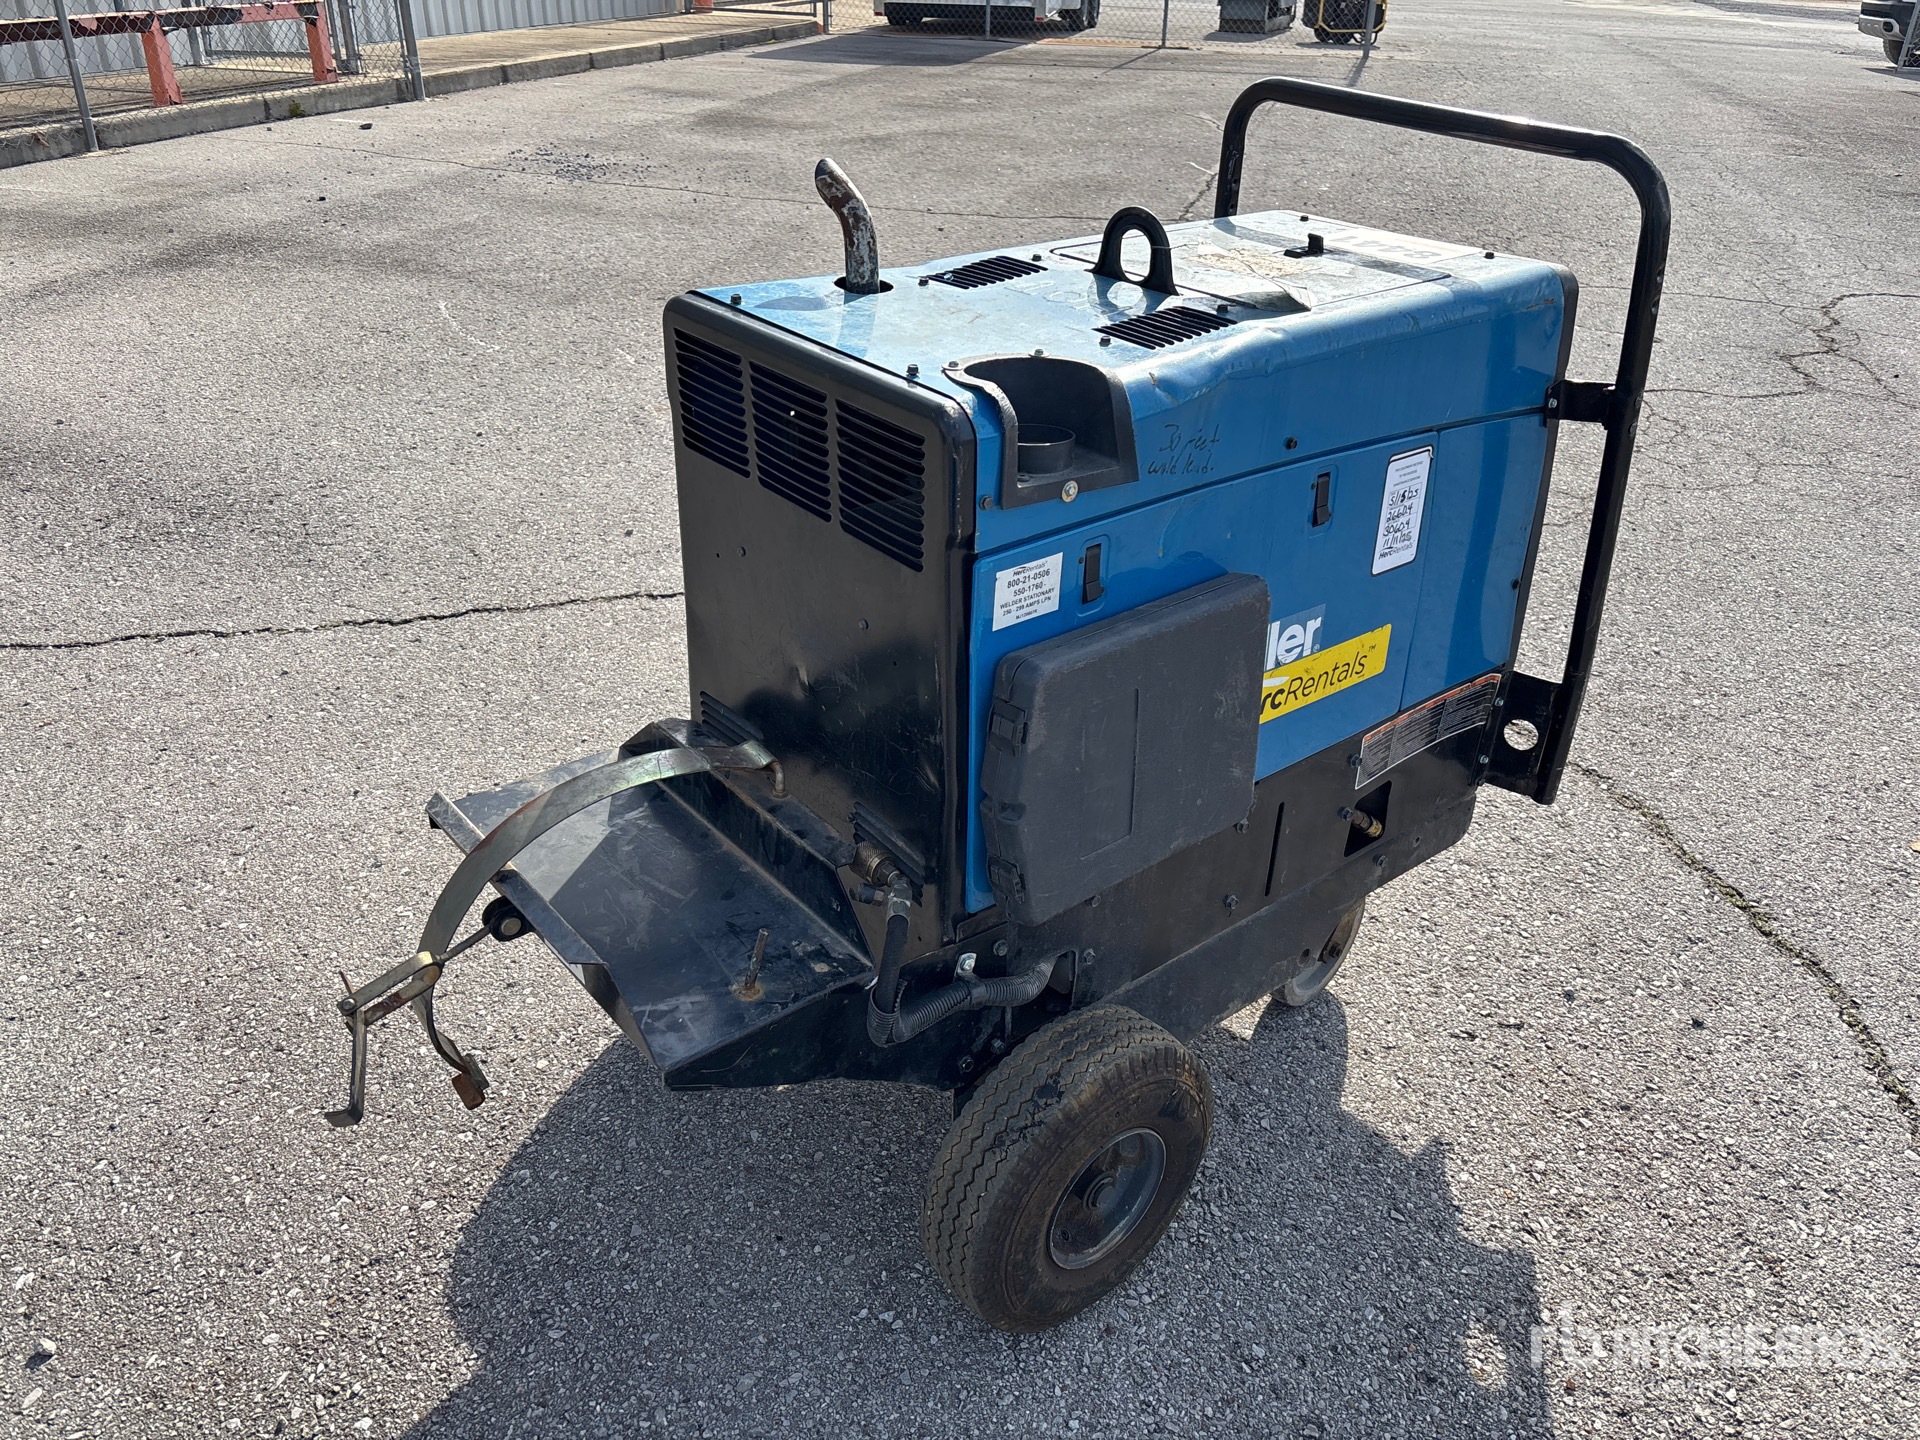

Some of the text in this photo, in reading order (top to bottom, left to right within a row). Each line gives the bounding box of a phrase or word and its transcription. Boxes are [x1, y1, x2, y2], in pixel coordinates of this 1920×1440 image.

[1007, 568, 1051, 589] 800-21-0506
[1000, 587, 1055, 610] WELDER STATIONARY
[1003, 608, 1013, 617] 250
[1025, 598, 1040, 609] AMPS
[1263, 616, 1322, 672] ler
[1260, 651, 1367, 716] rcRentals
